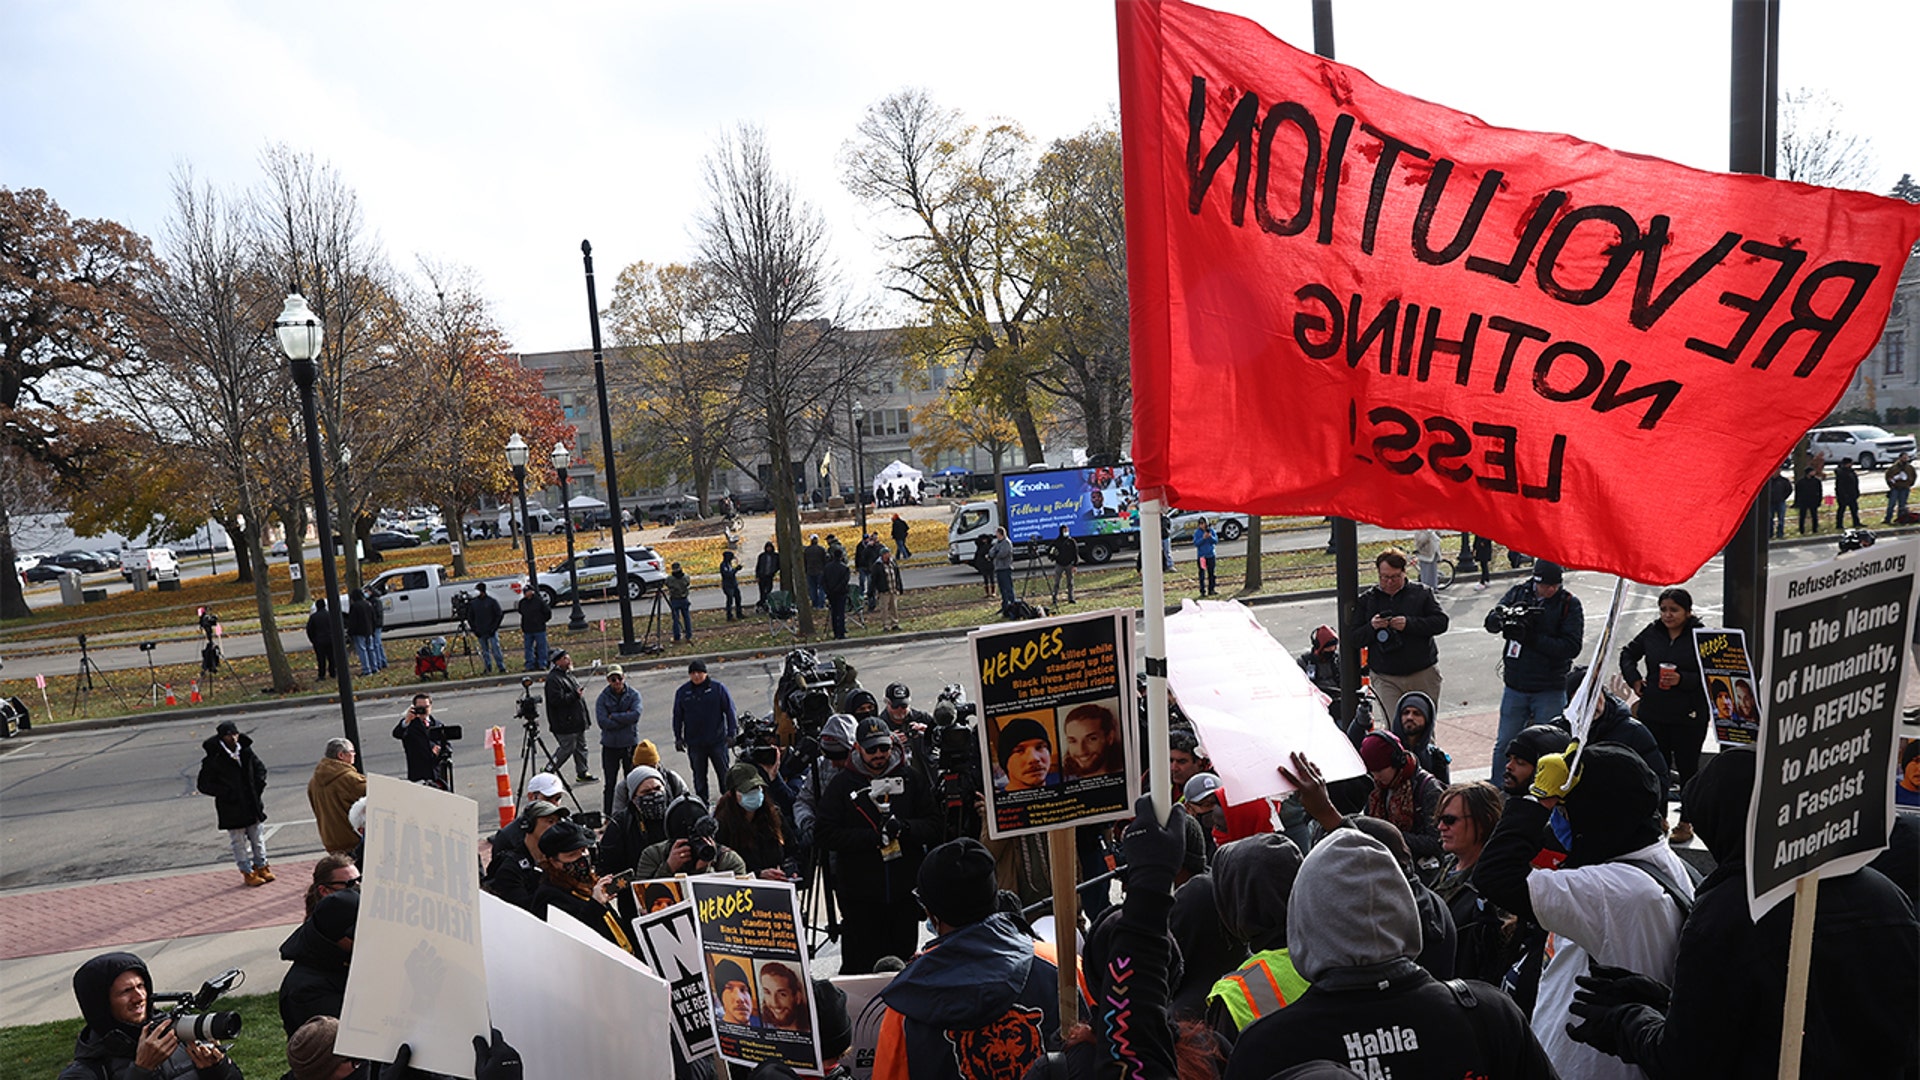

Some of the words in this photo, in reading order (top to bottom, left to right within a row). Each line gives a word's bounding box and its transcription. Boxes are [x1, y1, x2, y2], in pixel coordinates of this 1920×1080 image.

[1010, 503, 1041, 517] Follow
[1054, 495, 1084, 512] today!
[1788, 554, 1907, 599] RefuseFascism.org
[1782, 628, 1803, 658] In
[1808, 618, 1840, 650] the
[1844, 601, 1900, 638] Name
[982, 626, 1063, 685] HEROES
[1060, 647, 1087, 661] killed
[1089, 643, 1113, 655] while
[1699, 634, 1728, 658] HEROES
[1012, 677, 1039, 690] Black
[1041, 673, 1063, 686] lives
[1065, 669, 1082, 681] and
[1084, 664, 1115, 679] justice
[1046, 659, 1086, 674] standing
[1087, 656, 1099, 668] up
[1101, 653, 1114, 663] for
[1775, 670, 1798, 704] of
[1801, 642, 1897, 695] Humanity,
[1018, 688, 1028, 698] in
[1030, 685, 1045, 697] the
[1047, 679, 1088, 695] beautiful
[1090, 674, 1116, 687] rising
[1778, 712, 1808, 745] We
[1812, 682, 1887, 733] REFUSE
[1781, 758, 1801, 785] to
[1804, 728, 1872, 776] Accept
[1777, 803, 1790, 827] a
[1795, 770, 1865, 820] Fascist
[1774, 810, 1860, 869] America!
[700, 888, 754, 924] HEROES
[720, 924, 738, 934] Black
[646, 914, 702, 983] N
[676, 1000, 693, 1015] WE
[692, 994, 709, 1010] REF
[681, 983, 699, 997] THE
[683, 1015, 694, 1032] A
[857, 1048, 875, 1058] RA
[1342, 1025, 1419, 1058] Habla
